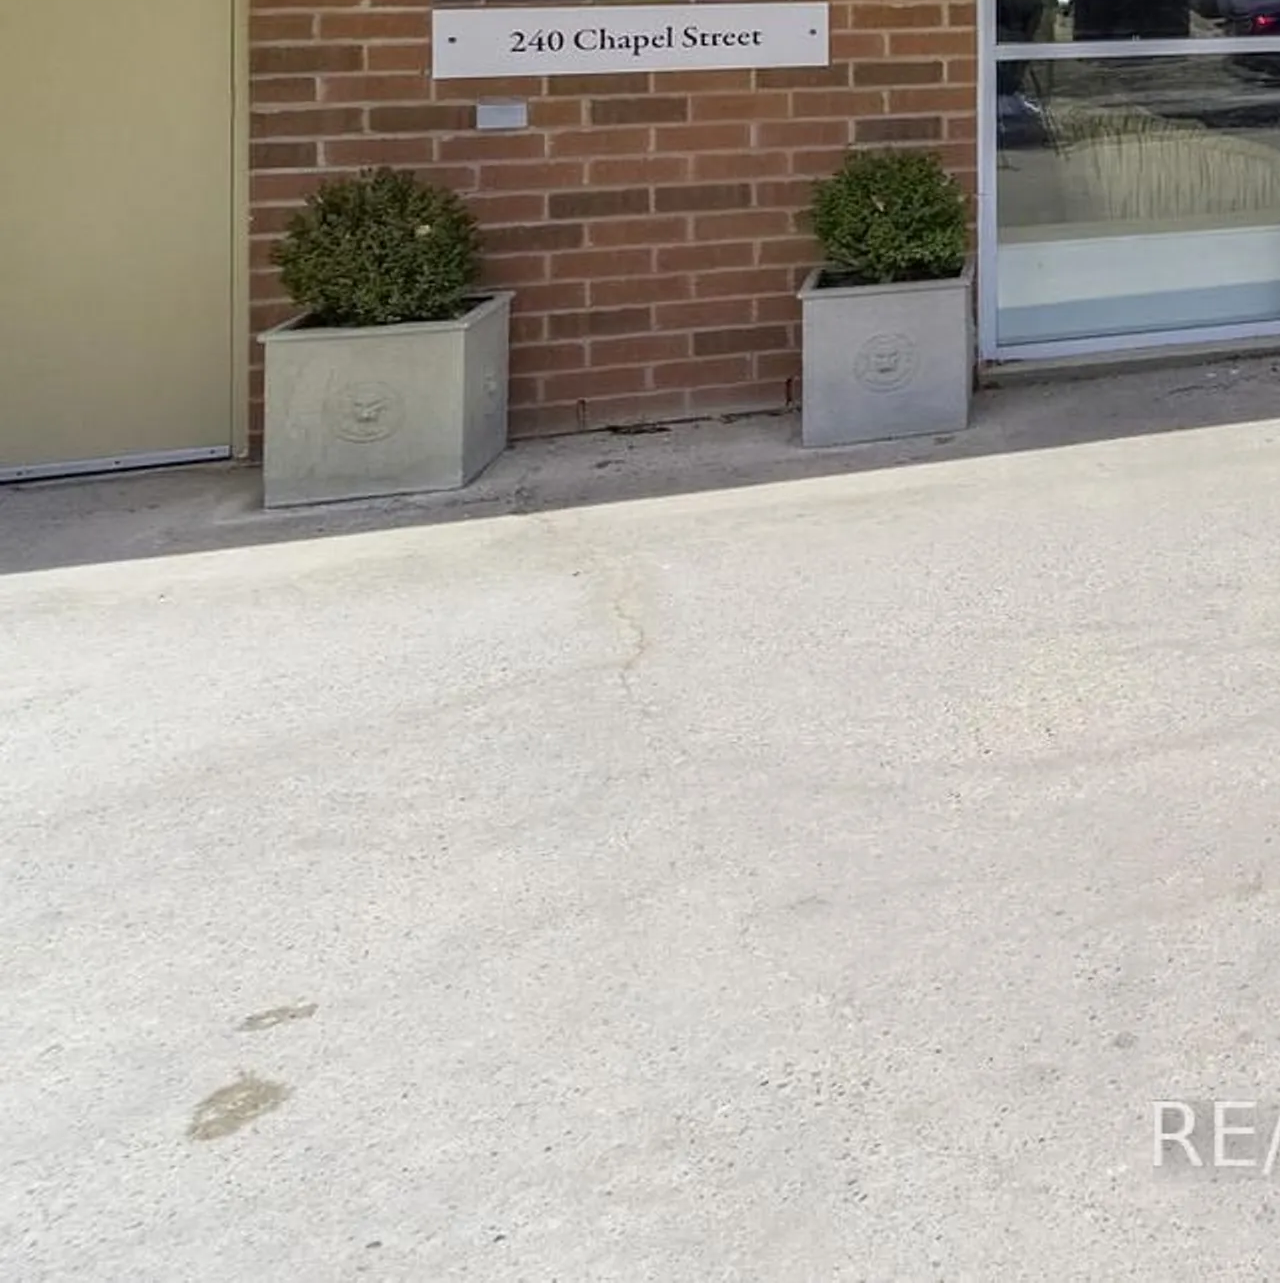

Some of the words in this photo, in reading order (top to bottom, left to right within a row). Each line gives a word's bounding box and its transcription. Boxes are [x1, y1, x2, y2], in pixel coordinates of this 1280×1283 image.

[509, 29, 564, 53] 240
[574, 27, 673, 56] Chapel
[681, 25, 762, 49] Street
